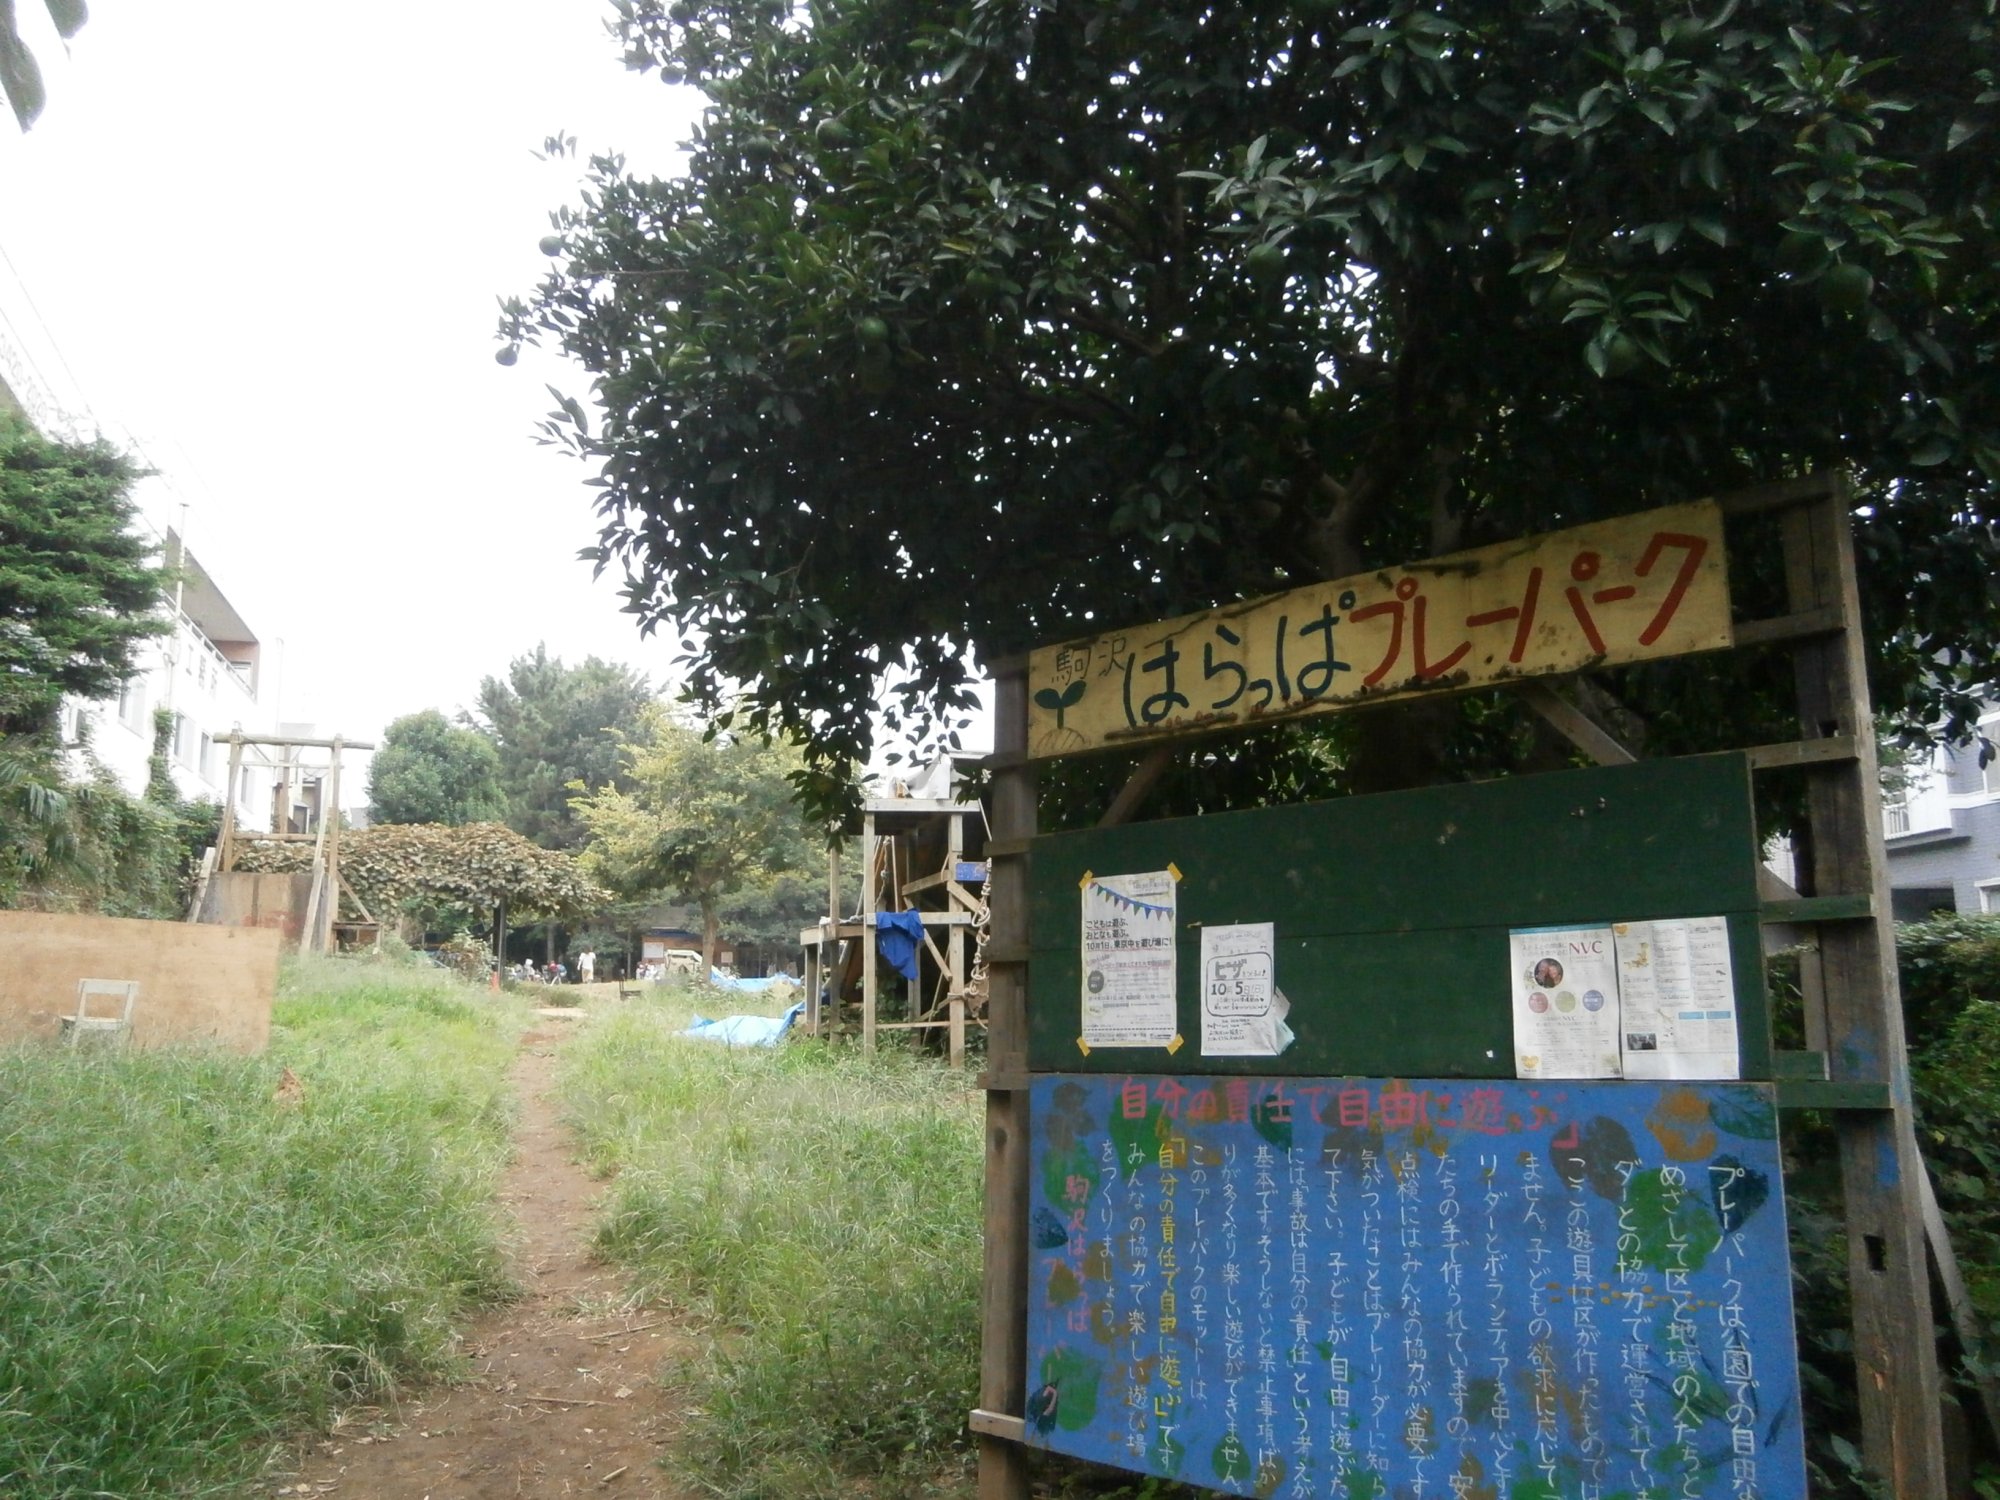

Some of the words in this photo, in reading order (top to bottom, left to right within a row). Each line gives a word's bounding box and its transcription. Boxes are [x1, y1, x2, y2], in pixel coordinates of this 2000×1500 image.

[1122, 531, 1708, 727] はらっぱプレーパーク
[1568, 940, 1603, 954] NVC
[1099, 1138, 1117, 1334] をつくりましょう。
[1126, 1142, 1151, 1457] みんなの協力で楽しい遊び場
[1480, 1153, 1517, 1500] リーダーとボランティアを中心とす
[1660, 1163, 1704, 1500] めざして区と地域の人たちと
